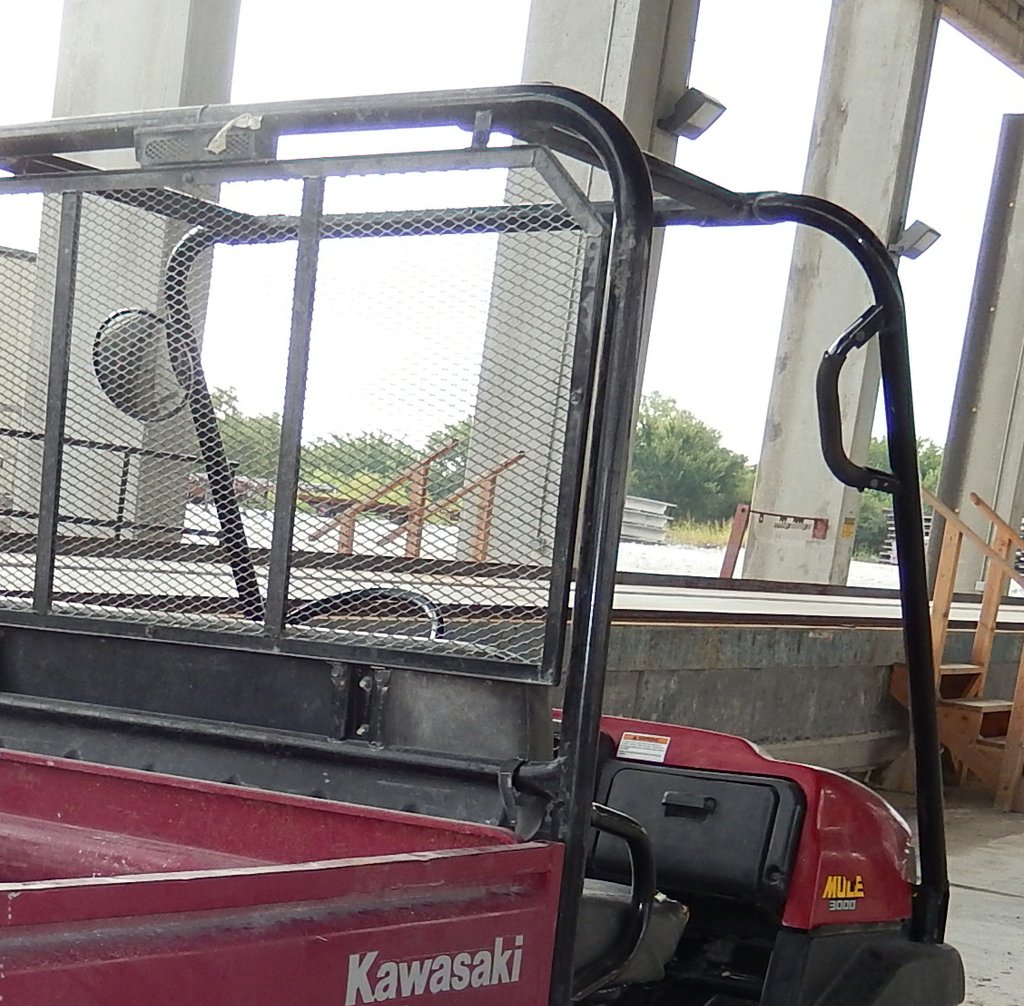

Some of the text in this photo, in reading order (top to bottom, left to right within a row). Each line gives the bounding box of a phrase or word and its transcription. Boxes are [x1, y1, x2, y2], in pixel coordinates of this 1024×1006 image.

[822, 875, 864, 898] MULE
[829, 900, 856, 910] 3000
[345, 935, 524, 1006] Kawasaki
